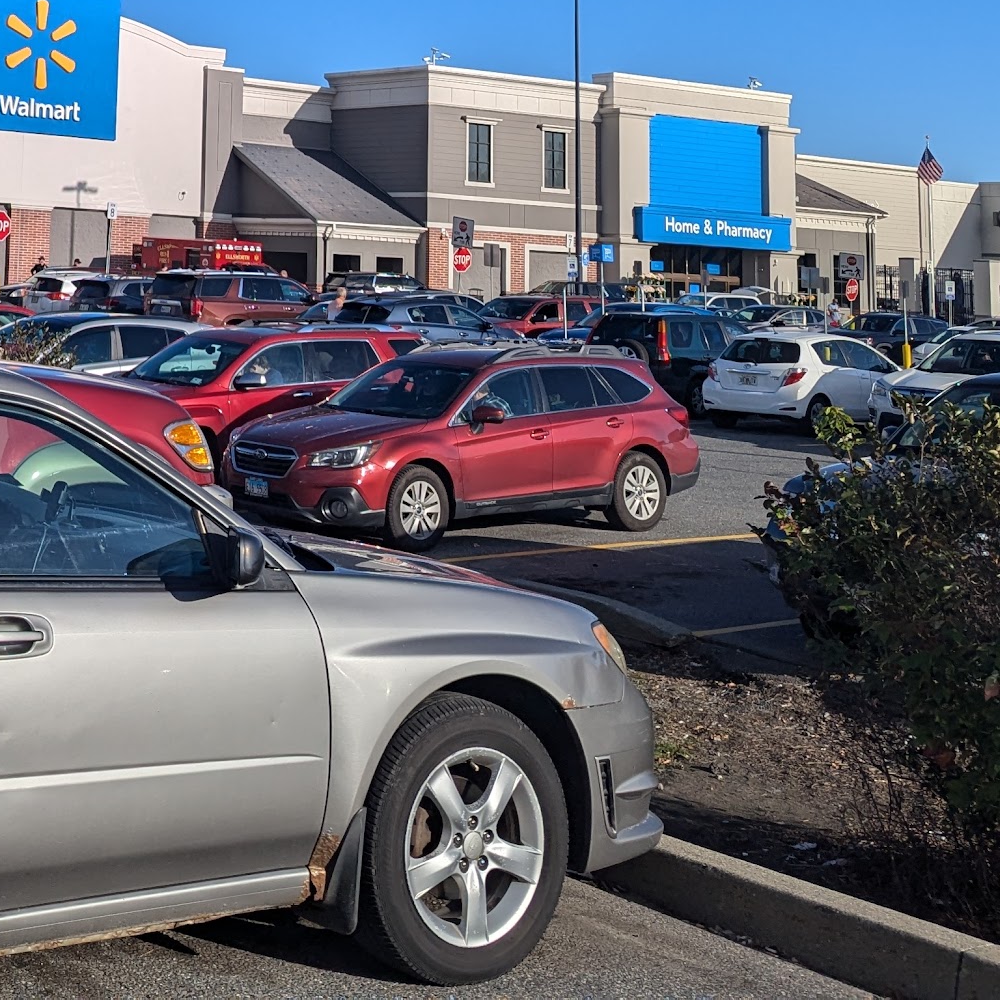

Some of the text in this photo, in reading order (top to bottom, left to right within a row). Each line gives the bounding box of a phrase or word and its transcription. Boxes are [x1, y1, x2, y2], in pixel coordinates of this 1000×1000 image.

[665, 216, 772, 244] Home & Pharmacy
[453, 254, 471, 265] STOP
[847, 285, 857, 295] STOP
